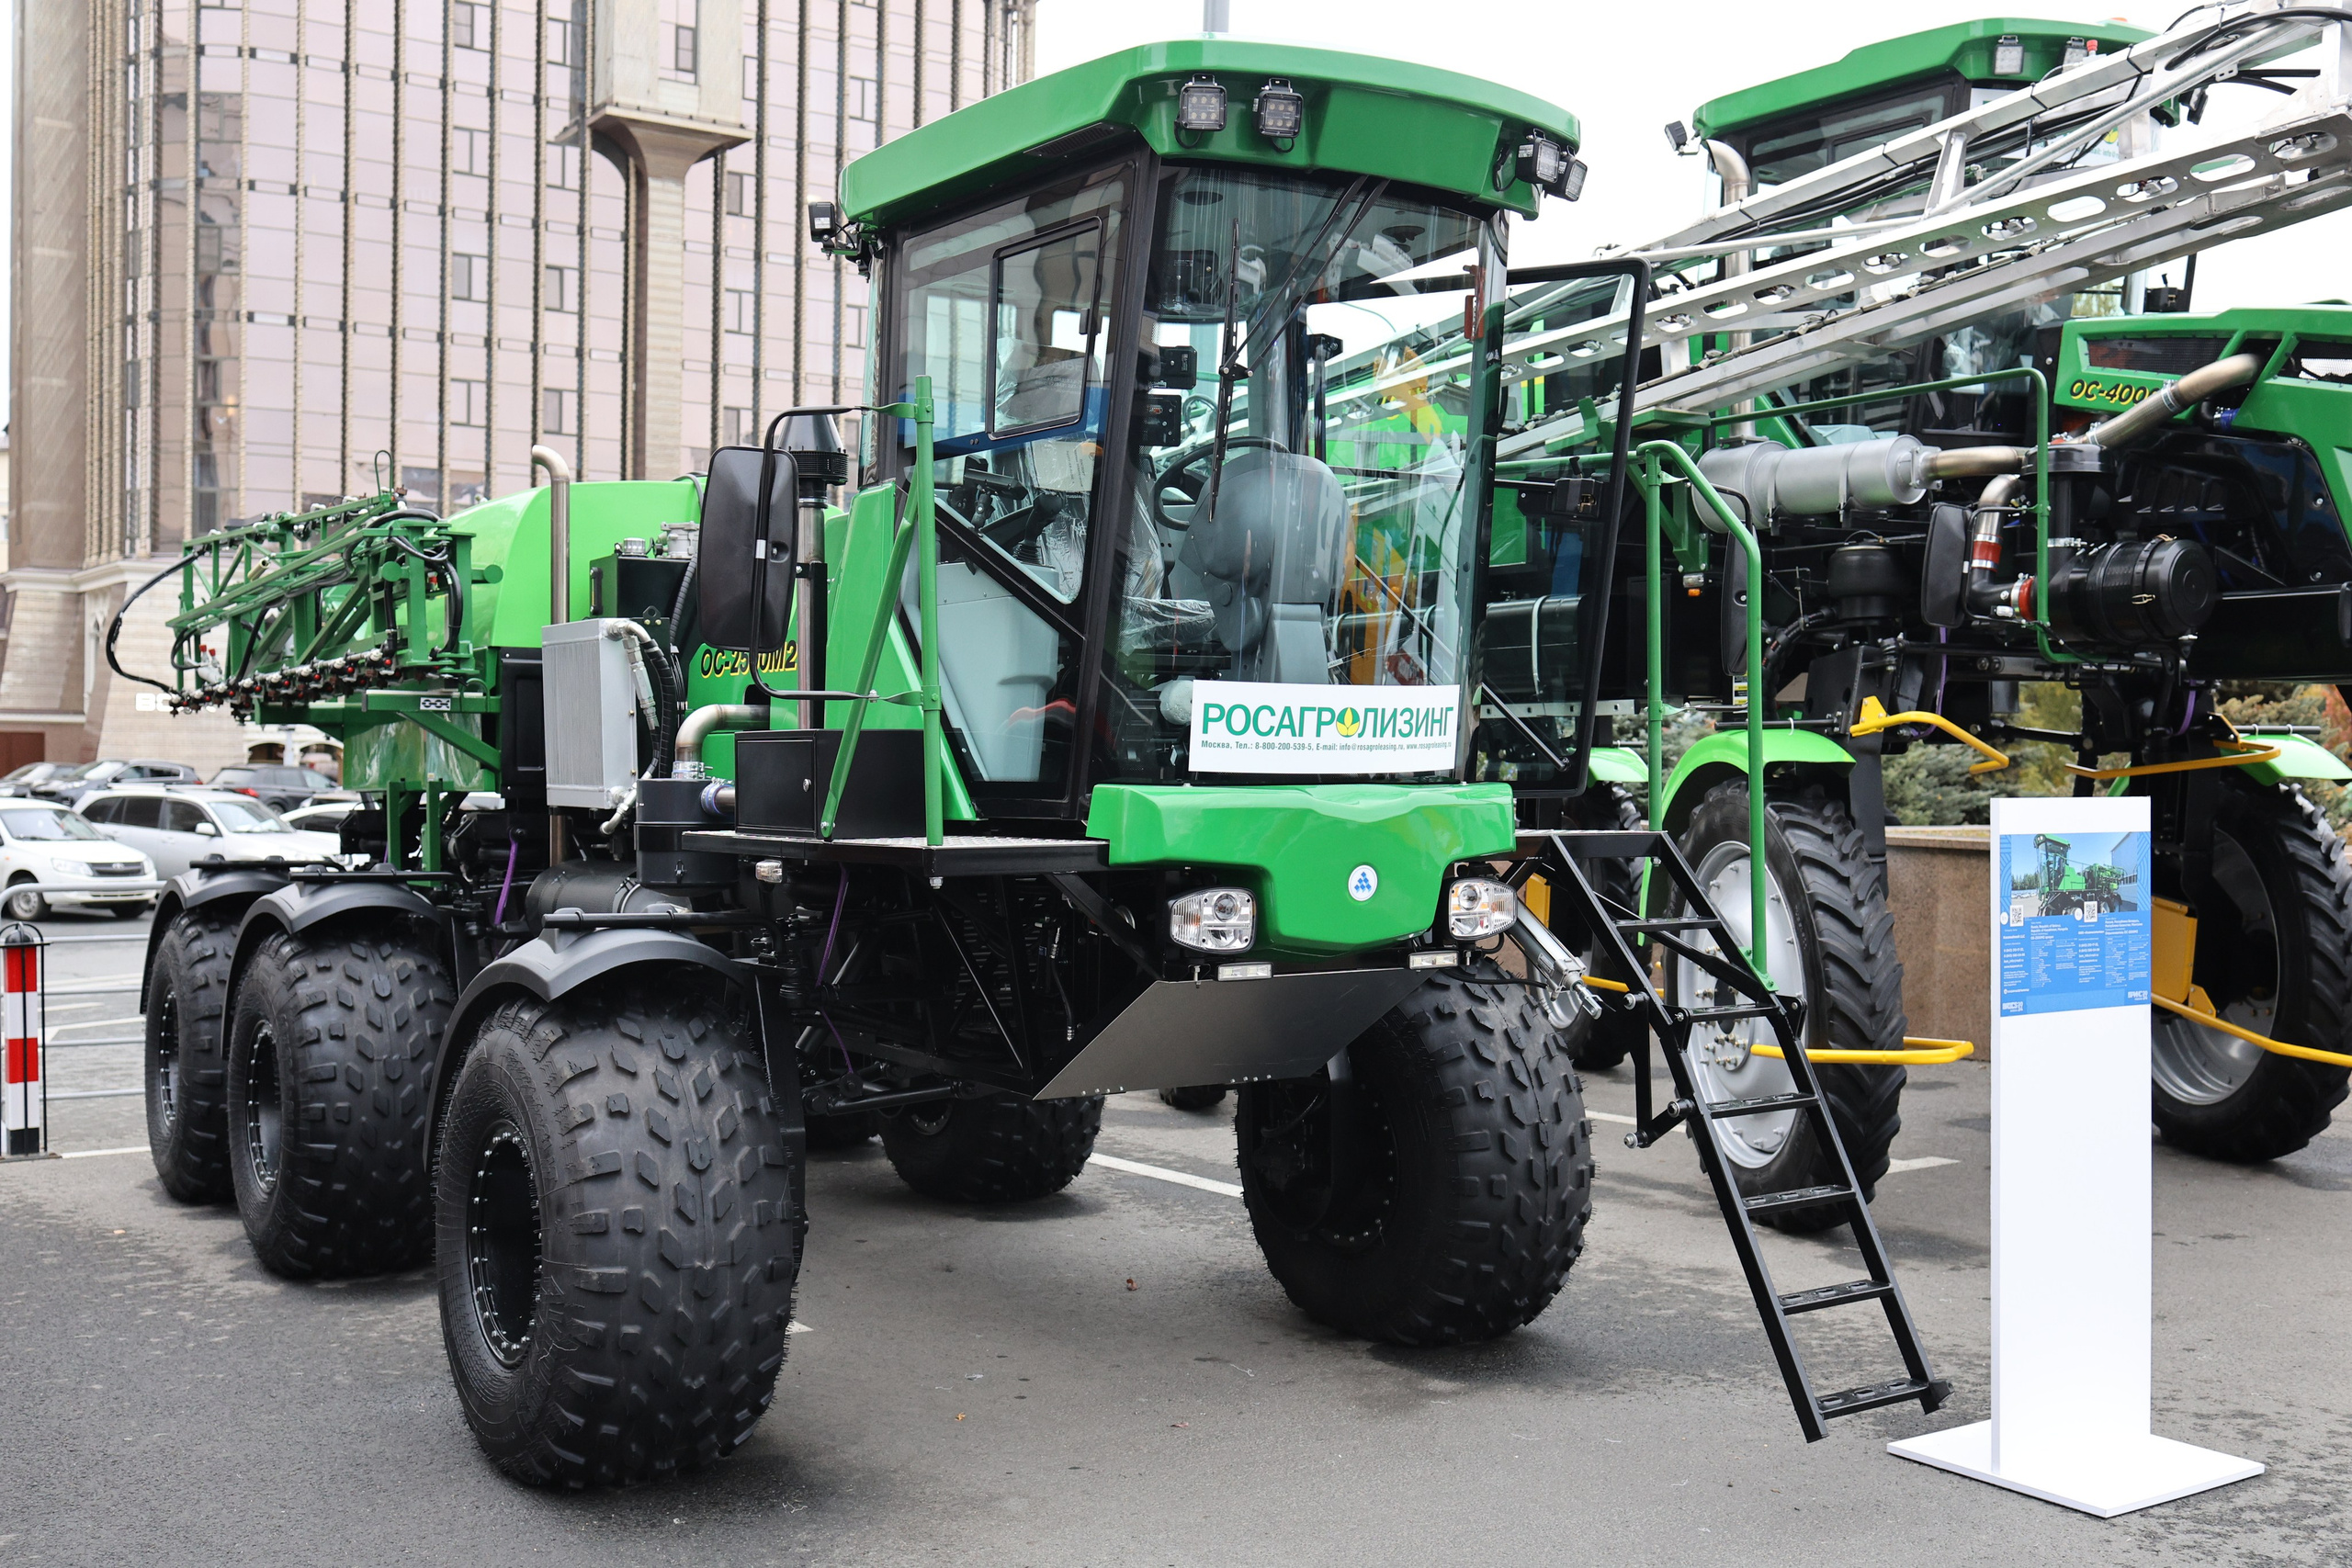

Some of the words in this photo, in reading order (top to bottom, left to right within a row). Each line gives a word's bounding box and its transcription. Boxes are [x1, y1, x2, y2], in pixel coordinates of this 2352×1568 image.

[2069, 378, 2160, 405] ОС-400
[700, 640, 798, 679] ОС-250М2
[1202, 703, 1453, 739] РОСАГРОЛИЗИНГ
[1201, 739, 1233, 750] Москва,
[1235, 740, 1253, 750] Тел.:
[1254, 741, 1314, 751] 8-800-200-539-5,
[1316, 742, 1338, 751] E-mail:
